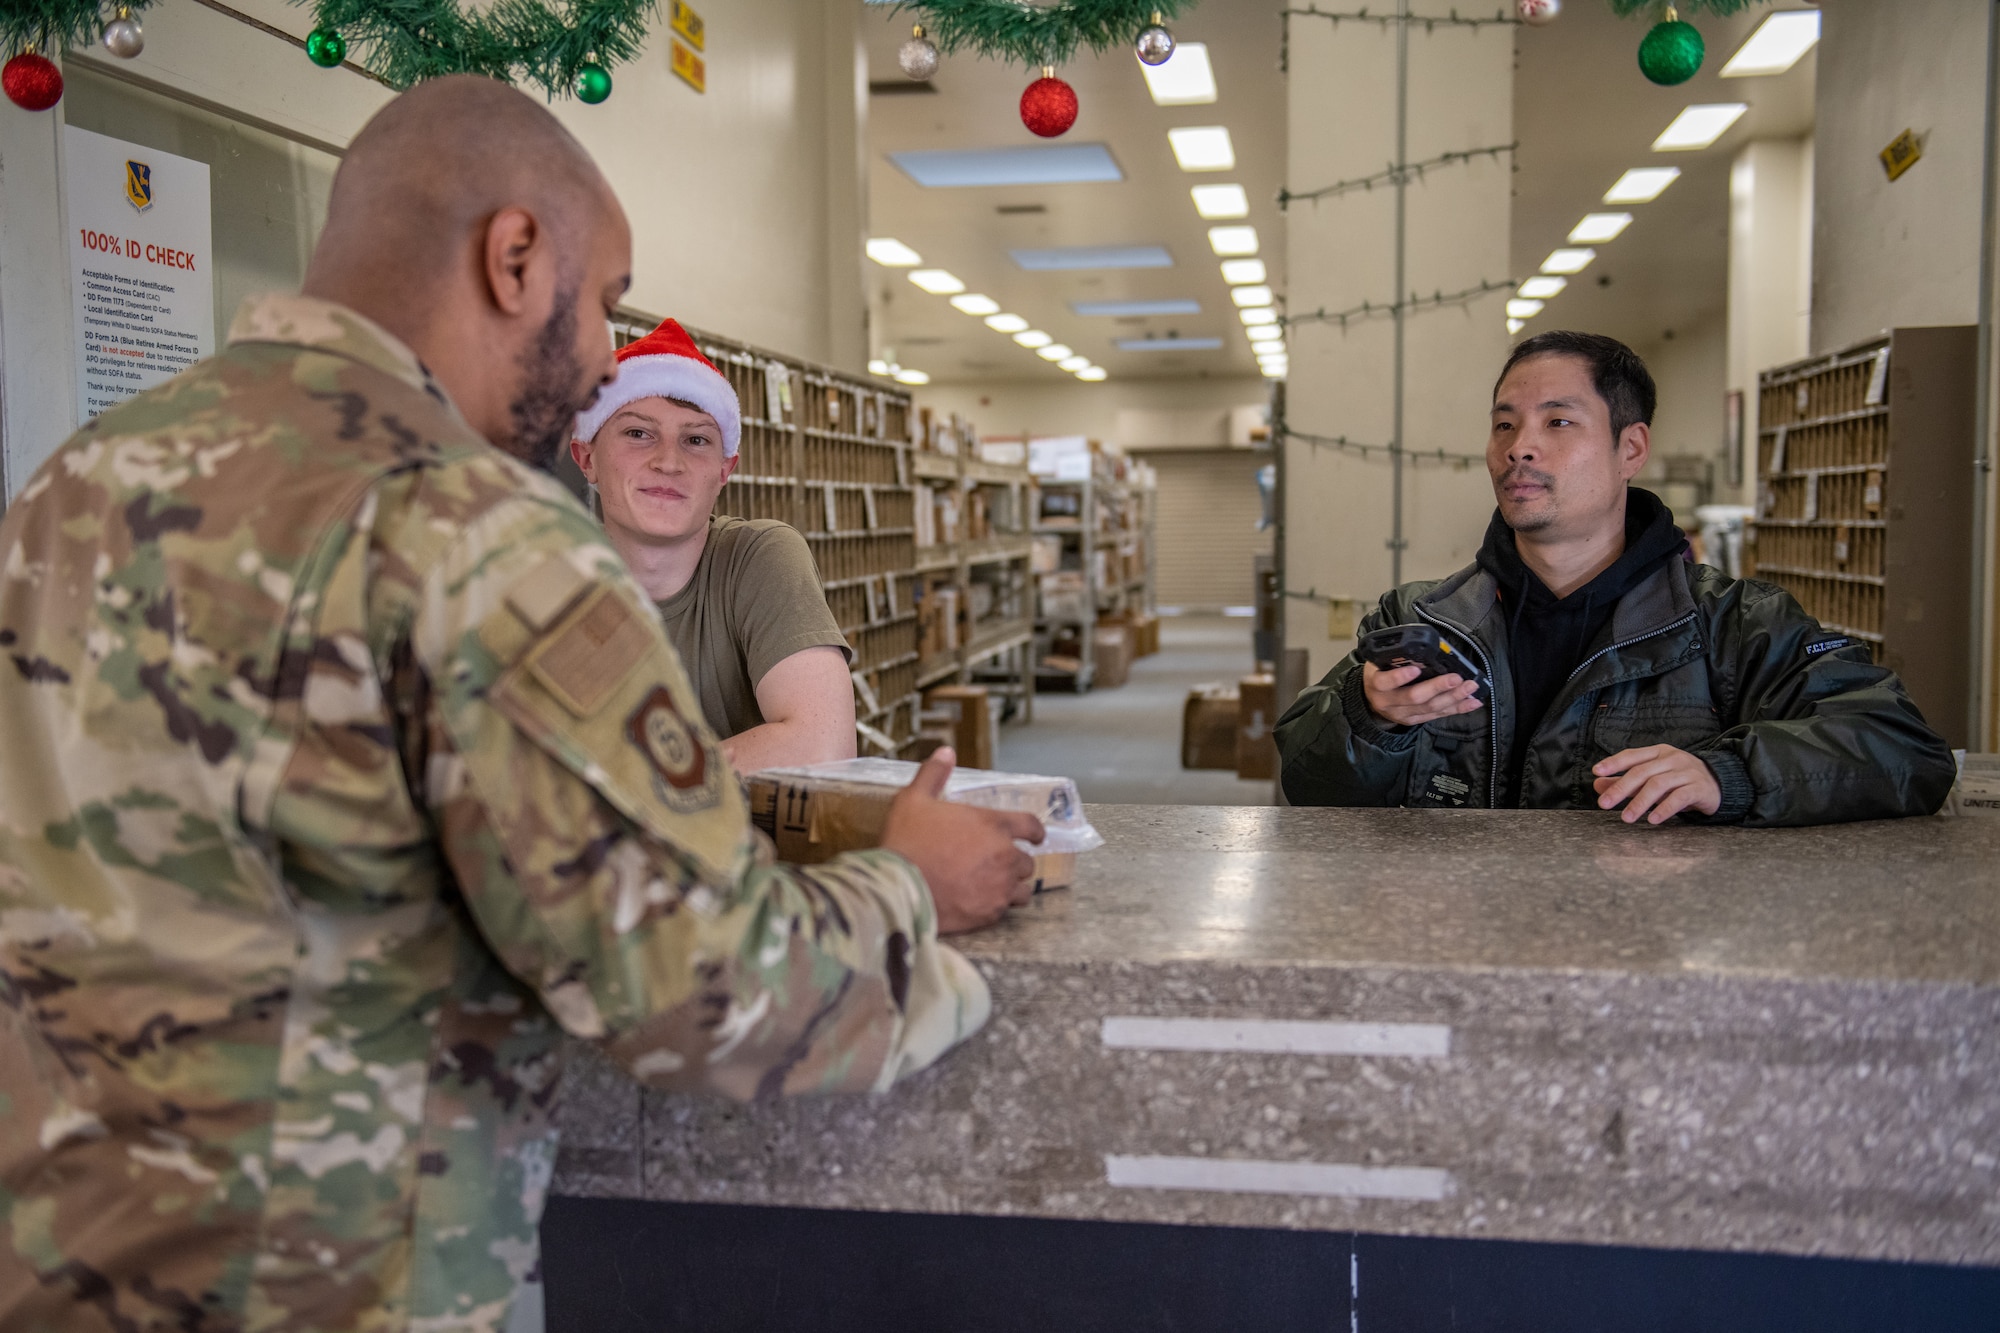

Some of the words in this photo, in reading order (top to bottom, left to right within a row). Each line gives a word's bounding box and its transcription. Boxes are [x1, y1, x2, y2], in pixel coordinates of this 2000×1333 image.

[80, 229, 121, 255] 100%
[126, 239, 141, 259] ID
[146, 244, 195, 271] CHECK
[82, 268, 113, 281] Acceptable
[114, 274, 132, 285] Forms
[139, 279, 175, 293] Identification:
[87, 281, 112, 292] Common
[113, 285, 131, 296] Access
[132, 289, 145, 299] Card
[146, 292, 160, 302] (CAC)
[87, 292, 96, 301] DD
[97, 294, 112, 304] Form
[113, 297, 124, 306] 1173
[125, 300, 152, 311] (Dependent
[159, 306, 171, 315] Card)
[87, 304, 103, 314] Local
[104, 306, 139, 320] Identification
[140, 313, 154, 322] Card
[84, 316, 110, 328] (Temporary
[111, 320, 125, 329] White
[125, 322, 131, 330] ID
[151, 326, 163, 335] SOFA
[163, 328, 177, 337] Status
[177, 330, 198, 341] Members)
[84, 330, 94, 340] DD
[95, 332, 110, 342] Form
[111, 334, 120, 343] 2A
[120, 336, 134, 346] (Blue
[135, 338, 155, 349] Retiree
[156, 341, 173, 351] Armed
[174, 344, 192, 354] Forces
[192, 347, 199, 355] ID
[85, 342, 101, 353] Card)
[102, 344, 108, 353] is
[109, 347, 118, 355] not
[119, 348, 145, 358] accepted
[145, 351, 156, 360] due
[156, 353, 163, 361] to
[164, 354, 192, 365] restrictions
[86, 354, 98, 363] APO
[99, 356, 126, 368] privileges
[126, 359, 136, 368] for
[136, 361, 156, 371] retirees
[156, 364, 177, 375] residing
[86, 366, 107, 376] without
[108, 369, 124, 378] SOFA
[124, 371, 142, 381] status.
[87, 381, 103, 391] Thank
[104, 385, 115, 393] you
[124, 387, 137, 396] your
[87, 397, 98, 406] For
[88, 408, 98, 417] the
